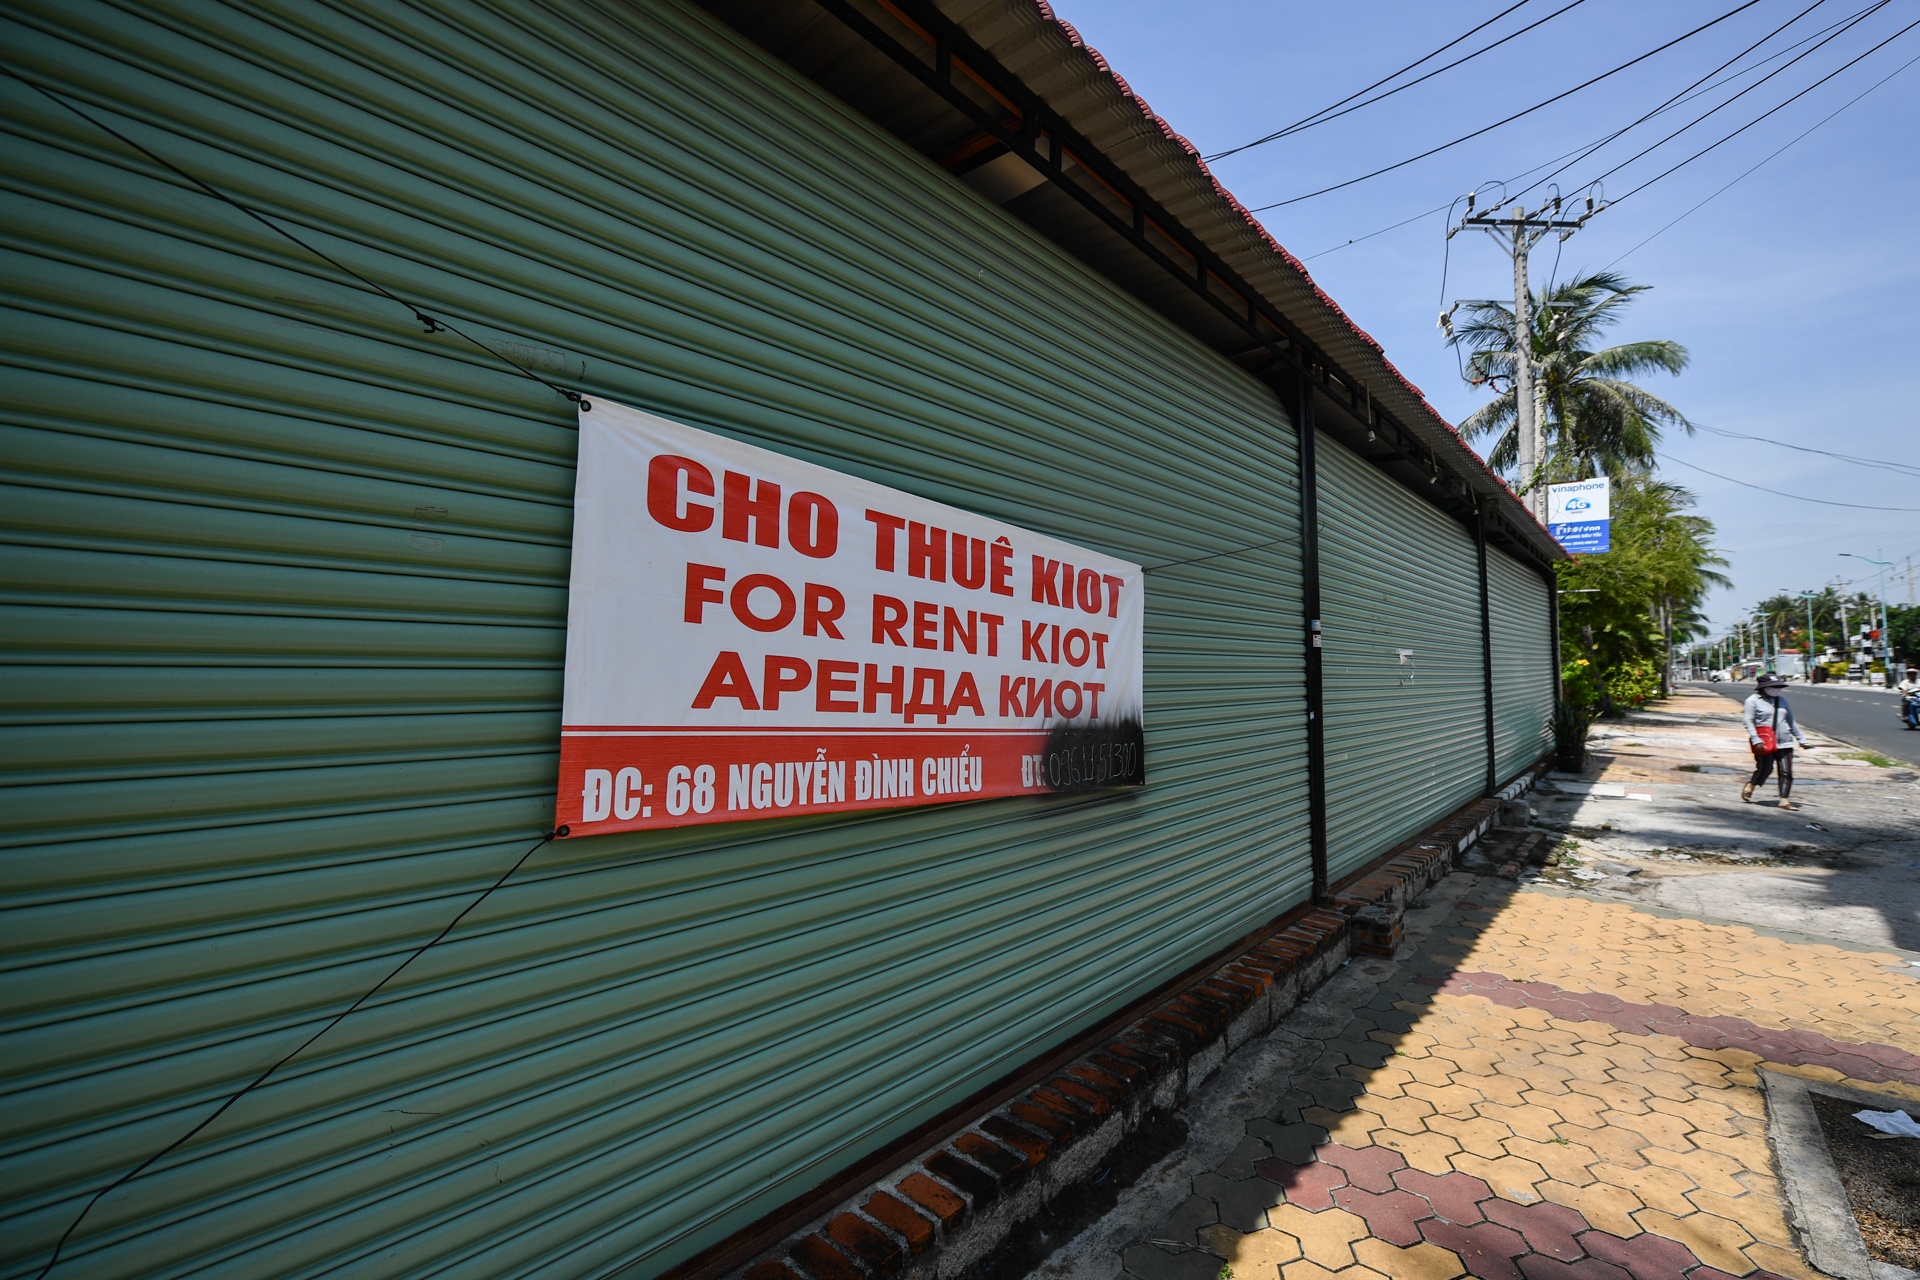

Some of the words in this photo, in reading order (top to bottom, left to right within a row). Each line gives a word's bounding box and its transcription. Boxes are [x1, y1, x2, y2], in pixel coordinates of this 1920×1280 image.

[1552, 483, 1604, 492] vinaphone
[1568, 500, 1587, 509] 4G
[647, 454, 839, 559] CHO
[865, 508, 1014, 595] THUÊ
[1031, 555, 1124, 618] KIOT
[684, 562, 845, 639] FOR
[872, 594, 1004, 656] RENT
[1022, 620, 1108, 669] KIOT
[691, 652, 985, 724] АРЕНДА
[999, 675, 1106, 719] КИОТ
[582, 766, 653, 821] ĐC:
[666, 764, 716, 815] 68
[728, 748, 845, 810] NGUYỄN
[854, 753, 914, 800] ĐÌNH
[922, 745, 982, 795] CHIỂU
